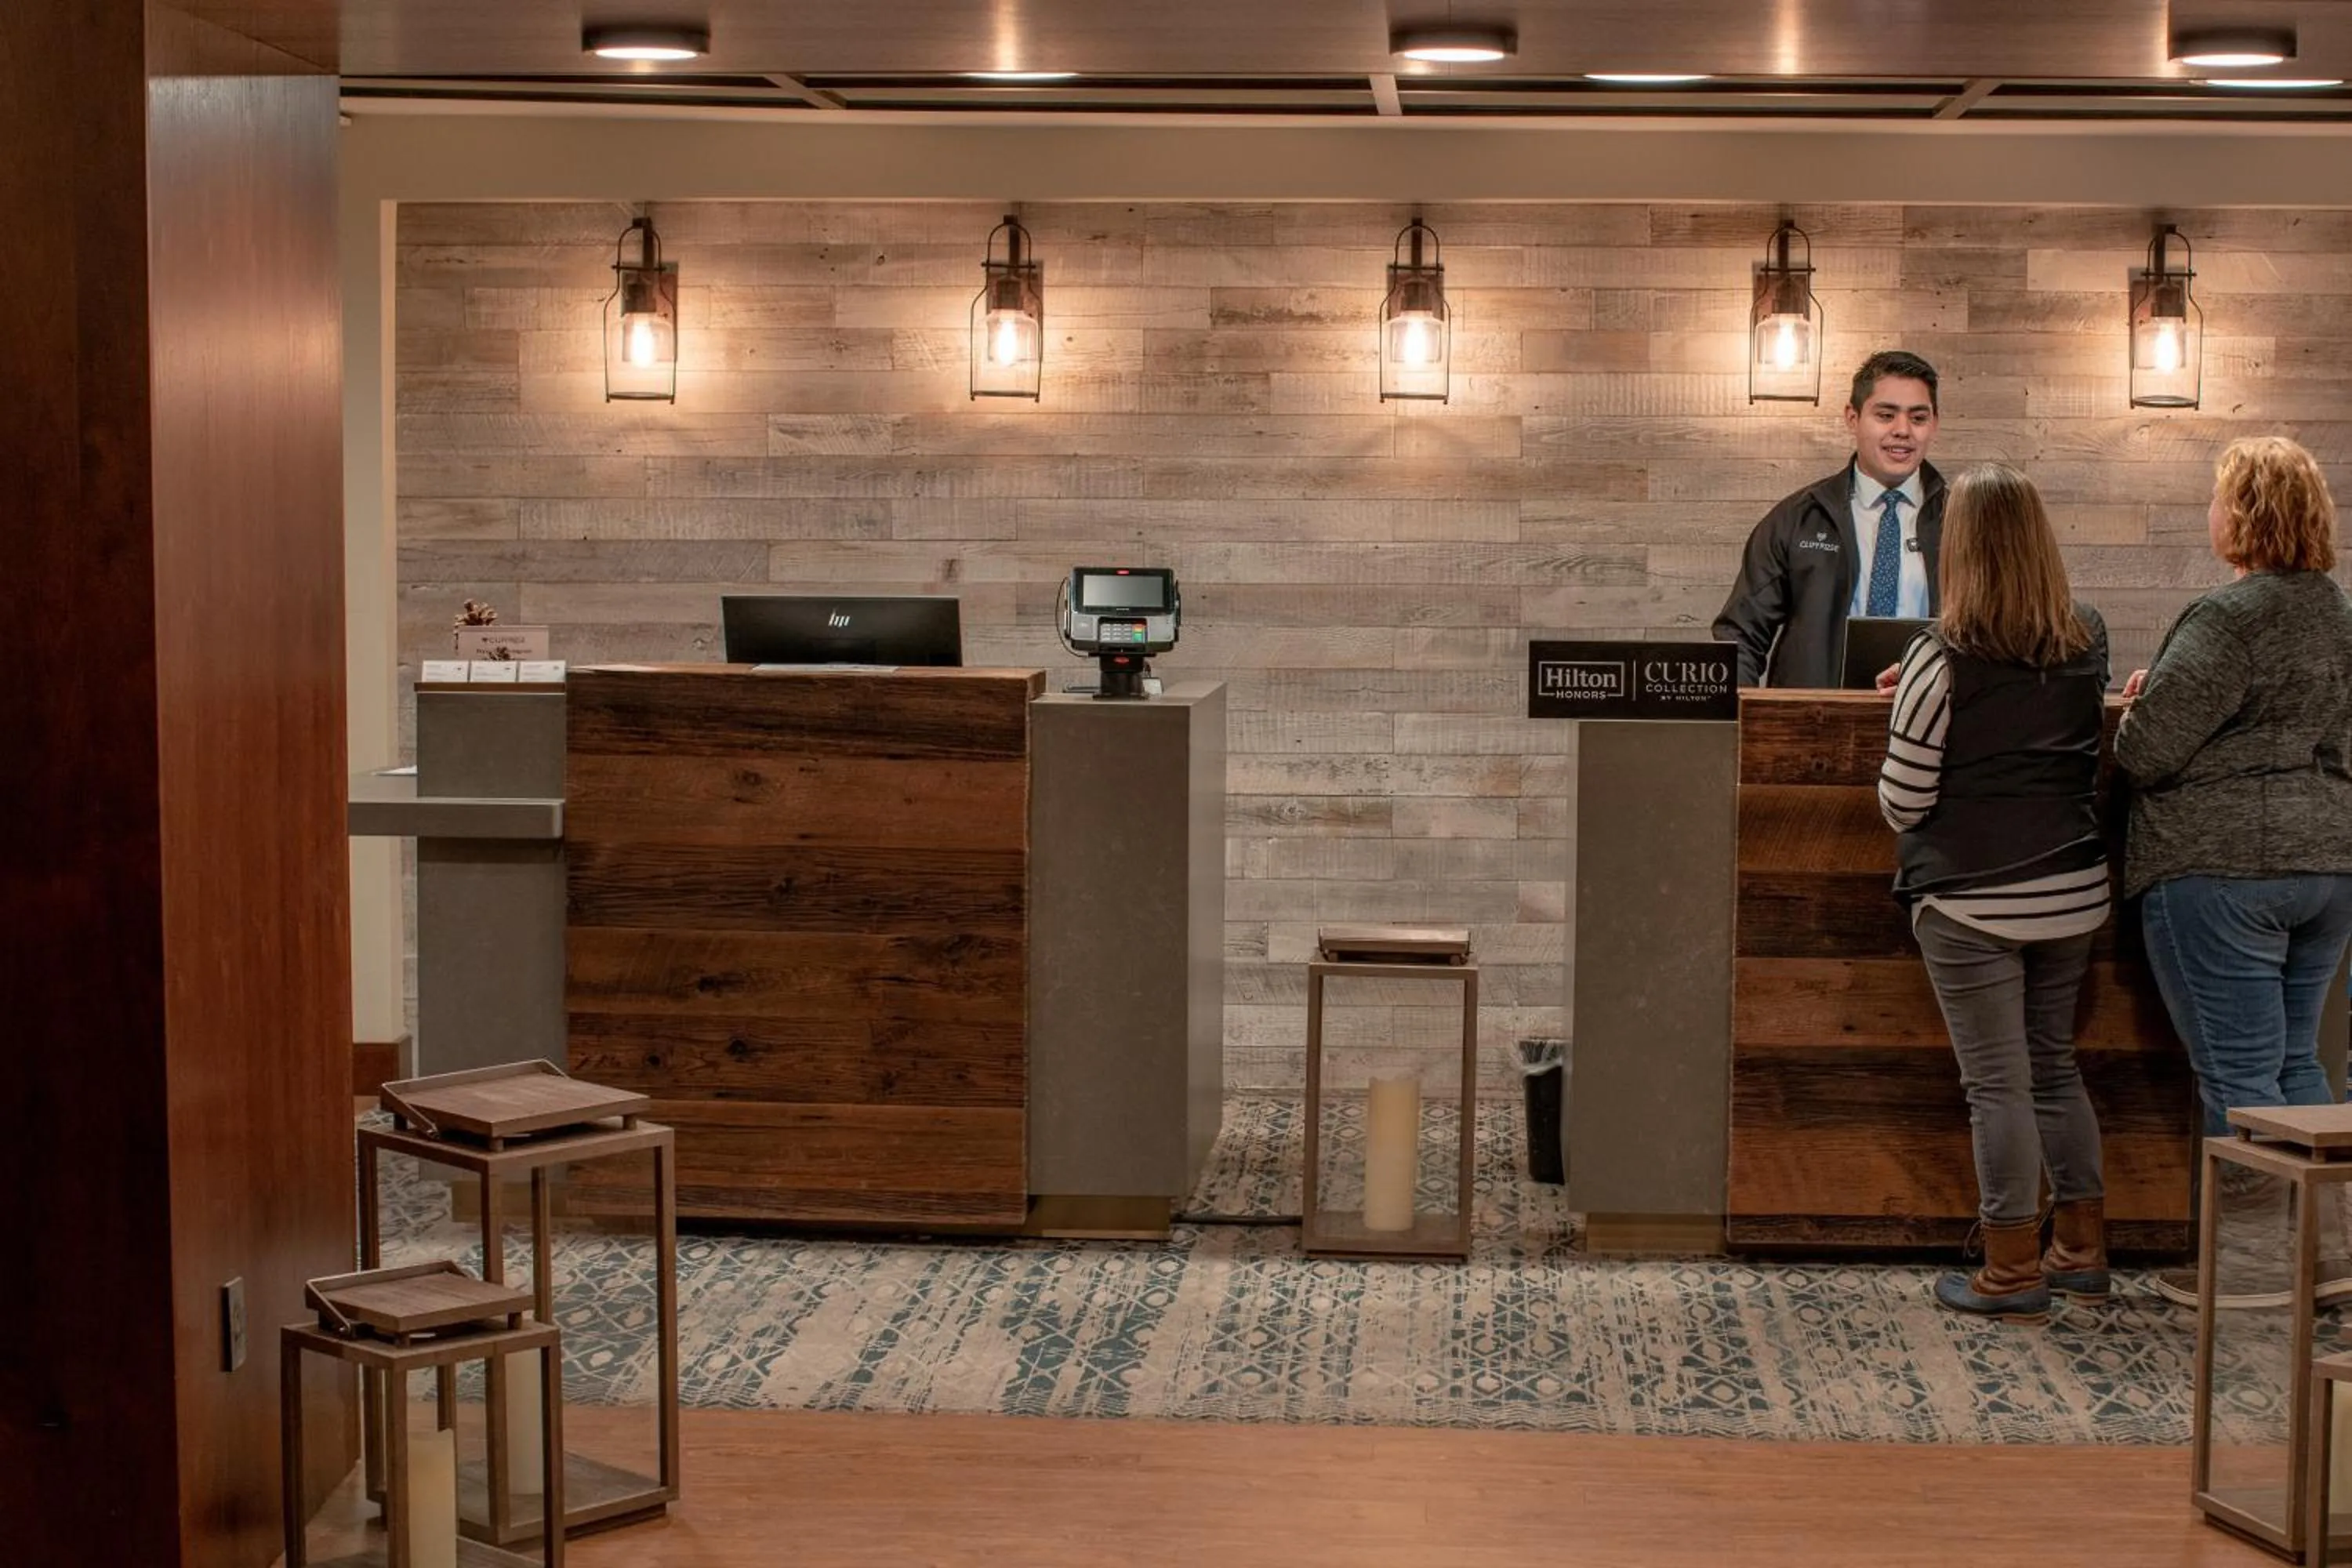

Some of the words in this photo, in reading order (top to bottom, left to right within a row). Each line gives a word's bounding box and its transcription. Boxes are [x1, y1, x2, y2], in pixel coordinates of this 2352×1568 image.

[828, 609, 851, 628] hp
[1545, 667, 1617, 688] Hilton
[1644, 662, 1729, 683] CURIO
[1556, 690, 1606, 699] HONORS
[1646, 684, 1727, 694] COLLECTION
